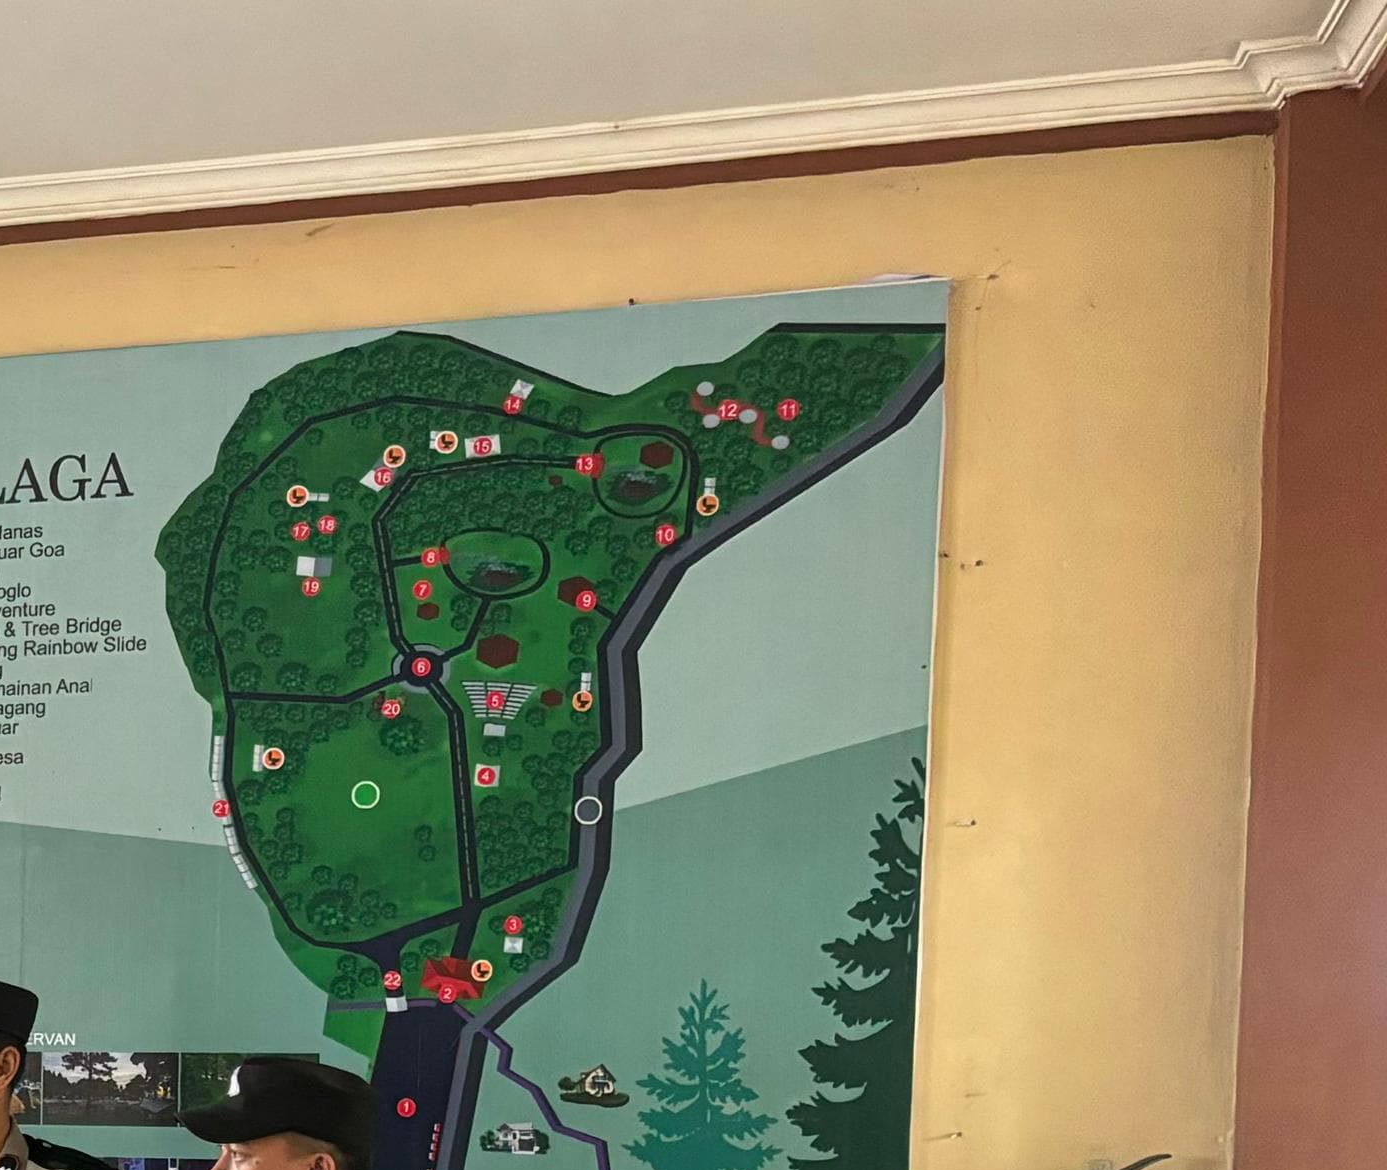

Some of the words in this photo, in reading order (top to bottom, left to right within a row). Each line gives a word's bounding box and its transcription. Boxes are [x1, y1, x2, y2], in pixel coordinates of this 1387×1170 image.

[505, 399, 520, 409] 14
[721, 404, 736, 417] 12
[782, 404, 795, 416] 11
[475, 441, 489, 452] 15
[579, 457, 593, 470] 13
[377, 471, 391, 482] 16
[320, 520, 334, 531] 18
[294, 526, 309, 537] 17
[658, 529, 674, 541] 10
[30, 542, 64, 557] Goa
[427, 552, 435, 563] 8
[304, 581, 319, 592] 19
[420, 584, 427, 595] 7
[583, 594, 591, 607] 9
[4, 621, 15, 637] &
[22, 621, 59, 636] Tree
[66, 617, 122, 636] Bridge
[24, 639, 98, 656] Rainbow
[104, 636, 146, 652] Slide
[418, 662, 427, 673] 6
[492, 695, 498, 707] 5
[383, 704, 399, 715] 20
[482, 771, 489, 781] 4
[214, 803, 229, 814] 21
[510, 917, 516, 930] 3
[385, 974, 400, 986] 22
[444, 988, 451, 999] 2
[27, 1032, 76, 1046] ERVAN
